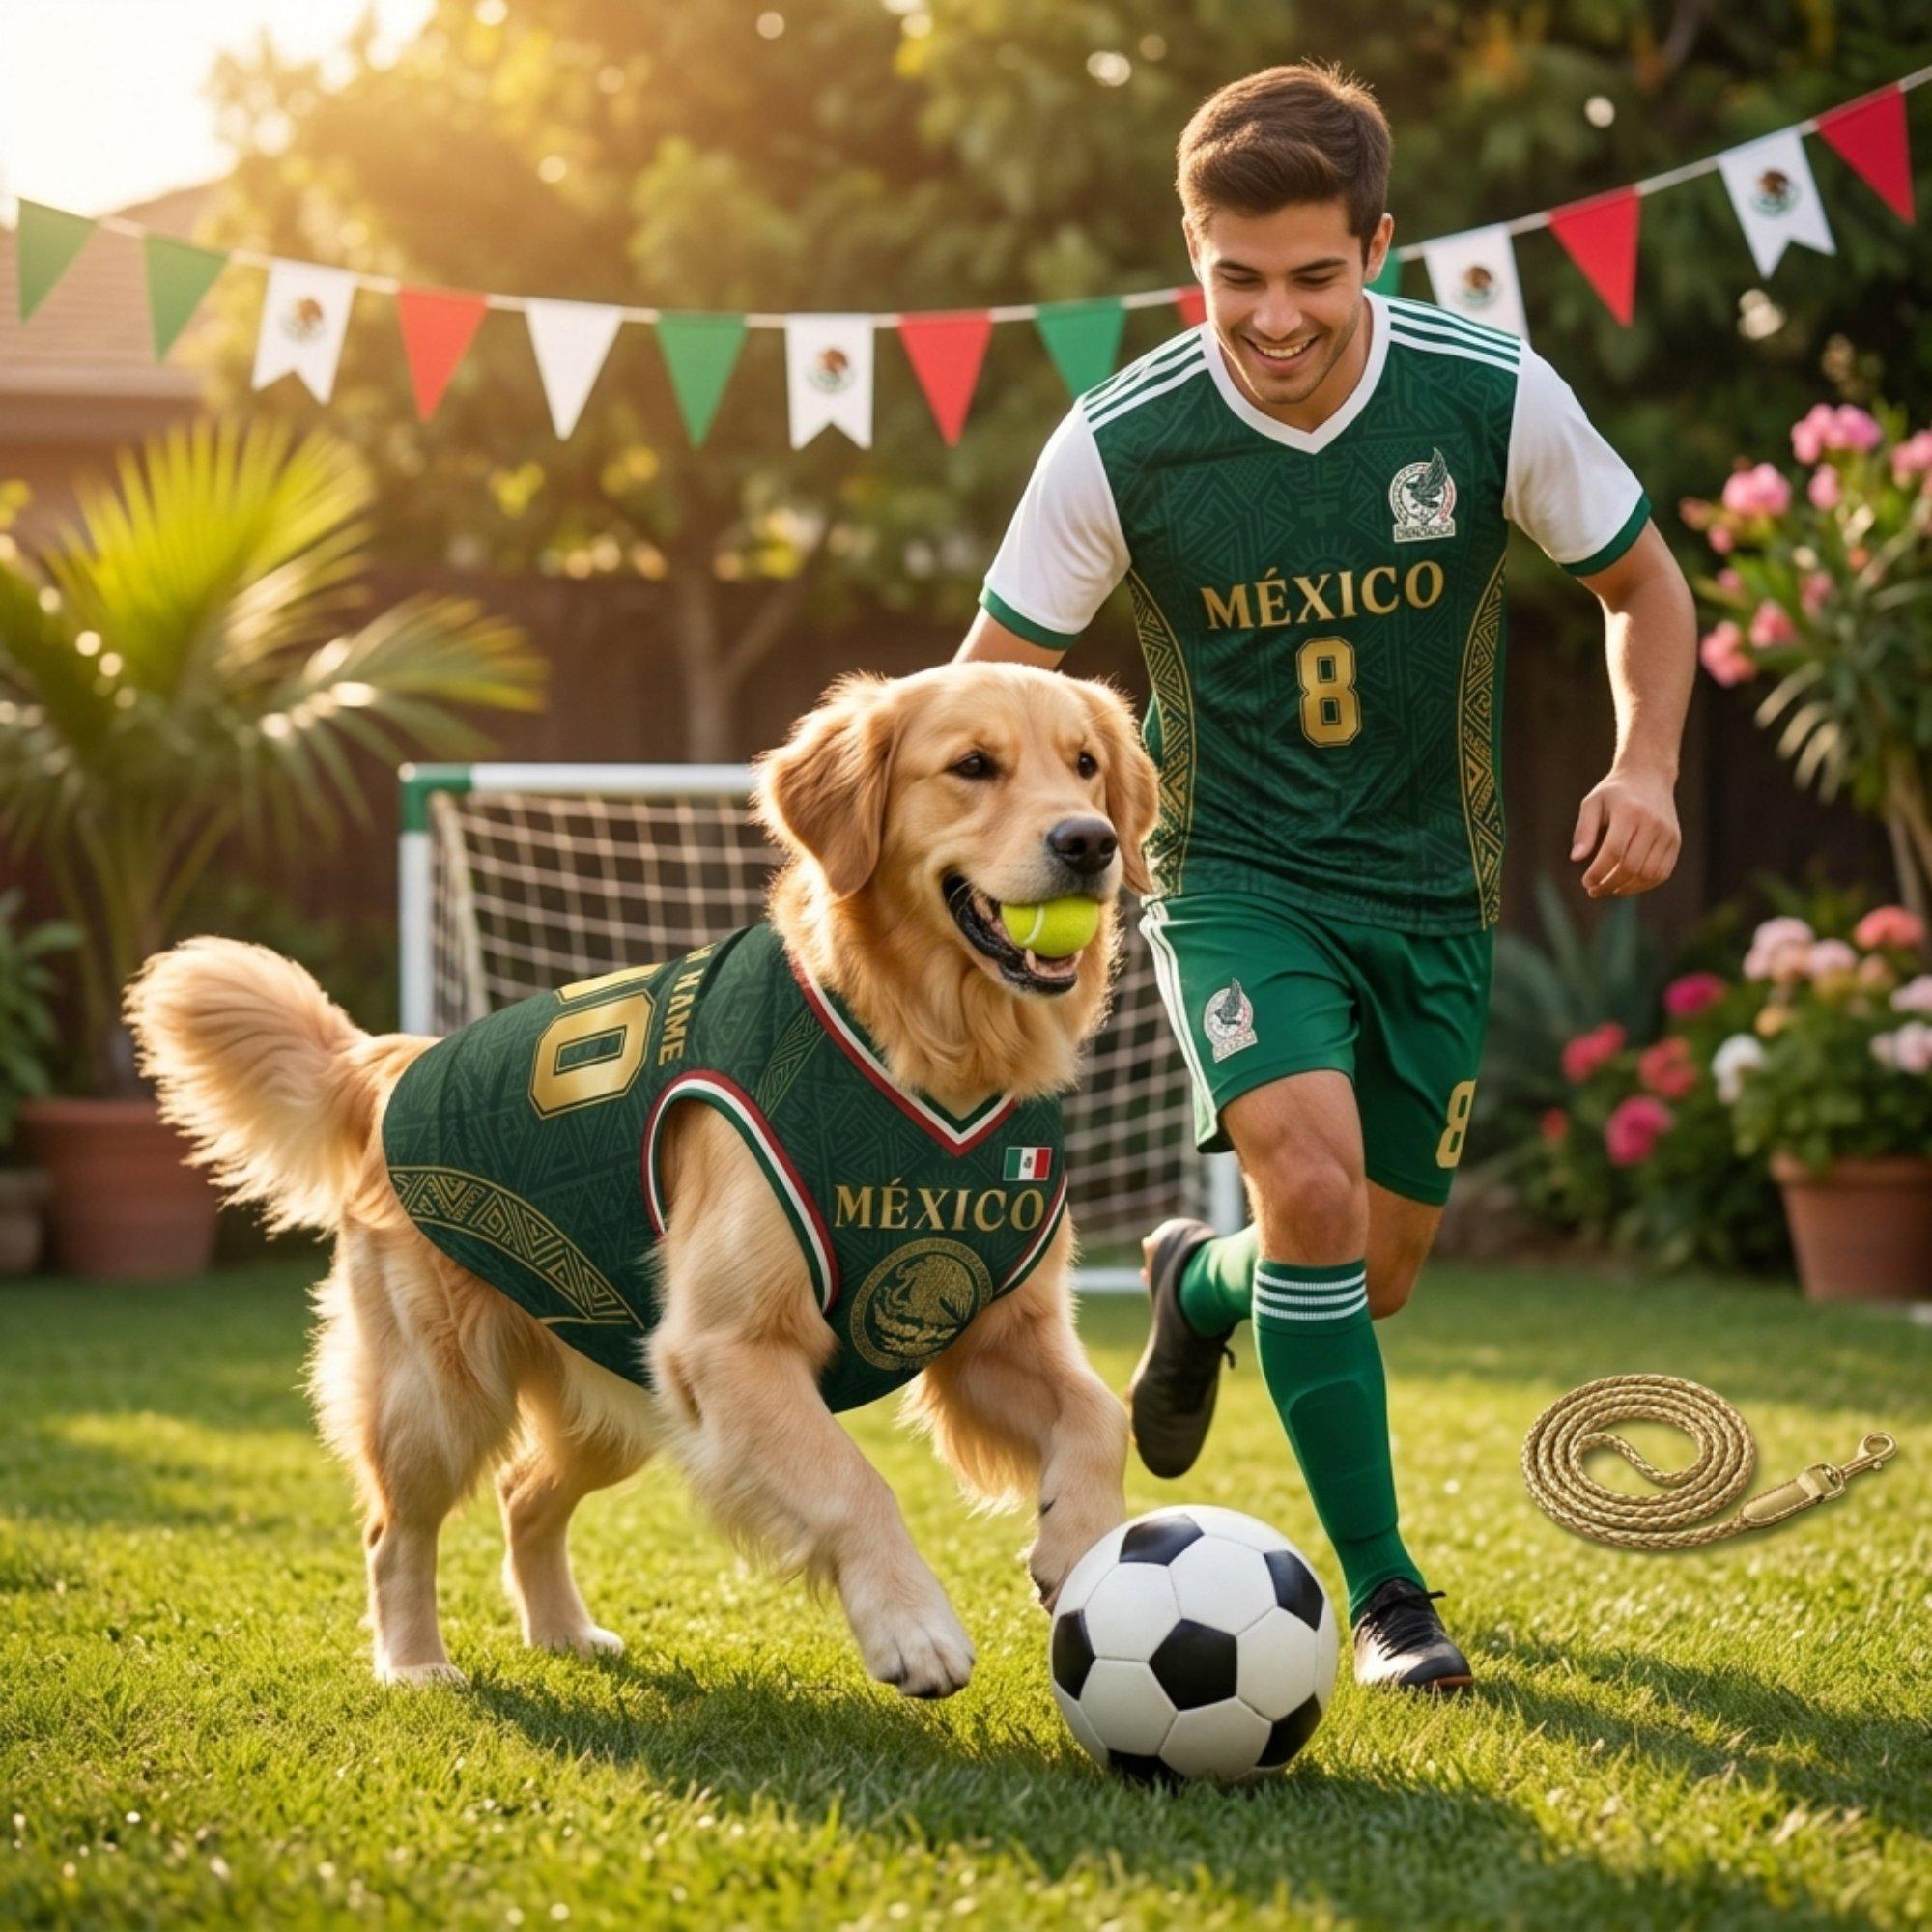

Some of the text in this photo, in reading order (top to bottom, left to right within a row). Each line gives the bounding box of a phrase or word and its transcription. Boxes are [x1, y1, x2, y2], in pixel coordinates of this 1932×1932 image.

[1200, 560, 1445, 630] MÉXICO
[1295, 636, 1362, 748] 8
[528, 962, 657, 1121] 0
[1435, 1079, 1476, 1169] 8
[834, 1177, 1045, 1232] MÉXICO
